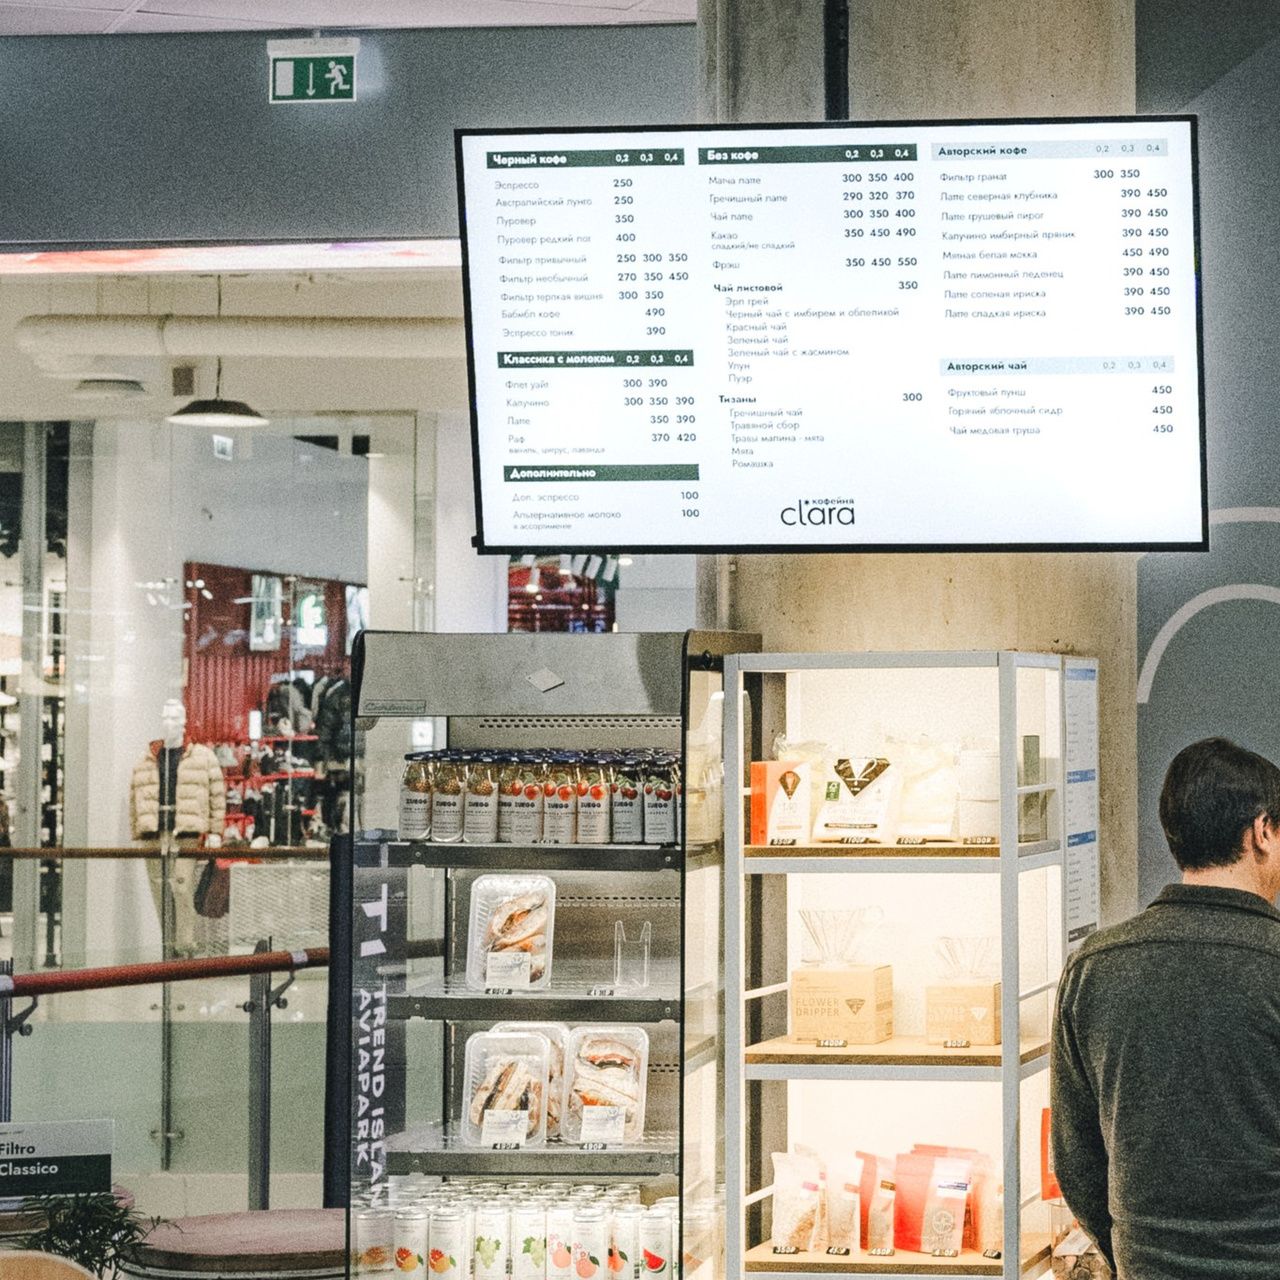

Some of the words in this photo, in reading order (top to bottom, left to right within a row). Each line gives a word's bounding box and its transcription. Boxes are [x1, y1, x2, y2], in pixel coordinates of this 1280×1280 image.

[707, 150, 729, 160] Без
[731, 150, 759, 161] кофе
[845, 149, 859, 159] 0,2
[870, 149, 883, 158] 0,3
[895, 148, 909, 157] 0,4
[939, 147, 996, 157] Авторский
[1000, 147, 1027, 156] кофе
[1096, 145, 1108, 153] 0,2
[1122, 144, 1134, 153] 0,3
[1146, 144, 1160, 153] 0,4
[493, 154, 535, 165] Черный
[538, 154, 567, 165] кофе
[615, 153, 629, 164] 0,2
[640, 153, 654, 163] 0,3
[664, 152, 679, 162] 0,4
[842, 174, 862, 182] 300
[868, 173, 887, 182] 350
[894, 173, 914, 181] 400
[1094, 170, 1114, 178] 300
[1120, 170, 1140, 178] 350
[613, 178, 633, 188] 250
[843, 192, 863, 200] 290
[869, 192, 888, 200] 320
[896, 192, 914, 200] 370
[844, 210, 863, 218] 300
[870, 210, 889, 218] 350
[895, 209, 915, 218] 400
[616, 214, 634, 224] 350
[844, 229, 864, 237] 350
[870, 228, 890, 237] 450
[896, 228, 916, 236] 490
[1122, 248, 1142, 256] 450
[1148, 248, 1169, 256] 490
[617, 254, 636, 262] 250
[643, 254, 662, 262] 300
[668, 253, 688, 262] 350
[846, 258, 865, 267] 350
[871, 258, 891, 266] 450
[898, 258, 917, 266] 550
[618, 272, 636, 282] 270
[644, 272, 663, 282] 350
[669, 272, 688, 280] 450
[714, 284, 733, 292] Чай
[737, 284, 783, 292] листовой
[898, 282, 918, 290] 350
[504, 354, 554, 364] Классика
[626, 355, 639, 364] 0,2
[650, 355, 663, 364] 0,3
[674, 354, 688, 363] 0,4
[948, 362, 1004, 372] Авторский
[1008, 361, 1027, 370] чай
[1103, 361, 1115, 369] 0,2
[1128, 361, 1141, 369] 0,3
[1153, 361, 1166, 369] 0,4
[1152, 386, 1172, 394] 450
[624, 397, 643, 406] 300
[650, 397, 668, 405] 350
[676, 397, 694, 405] 390
[903, 393, 922, 401] 300
[650, 416, 669, 424] 350
[676, 416, 695, 424] 390
[652, 434, 670, 442] 370
[677, 433, 696, 442] 420
[510, 469, 596, 479] Дополнительно
[812, 497, 854, 506] кофейня
[781, 499, 855, 526] clara
[795, 997, 840, 1007] FLOWER
[795, 1007, 840, 1017] DRIPPER
[372, 982, 387, 1099] TREND
[356, 988, 372, 1167] AVIAPARK
[0, 1141, 36, 1156] Filtro
[0, 1162, 59, 1177] Classico
